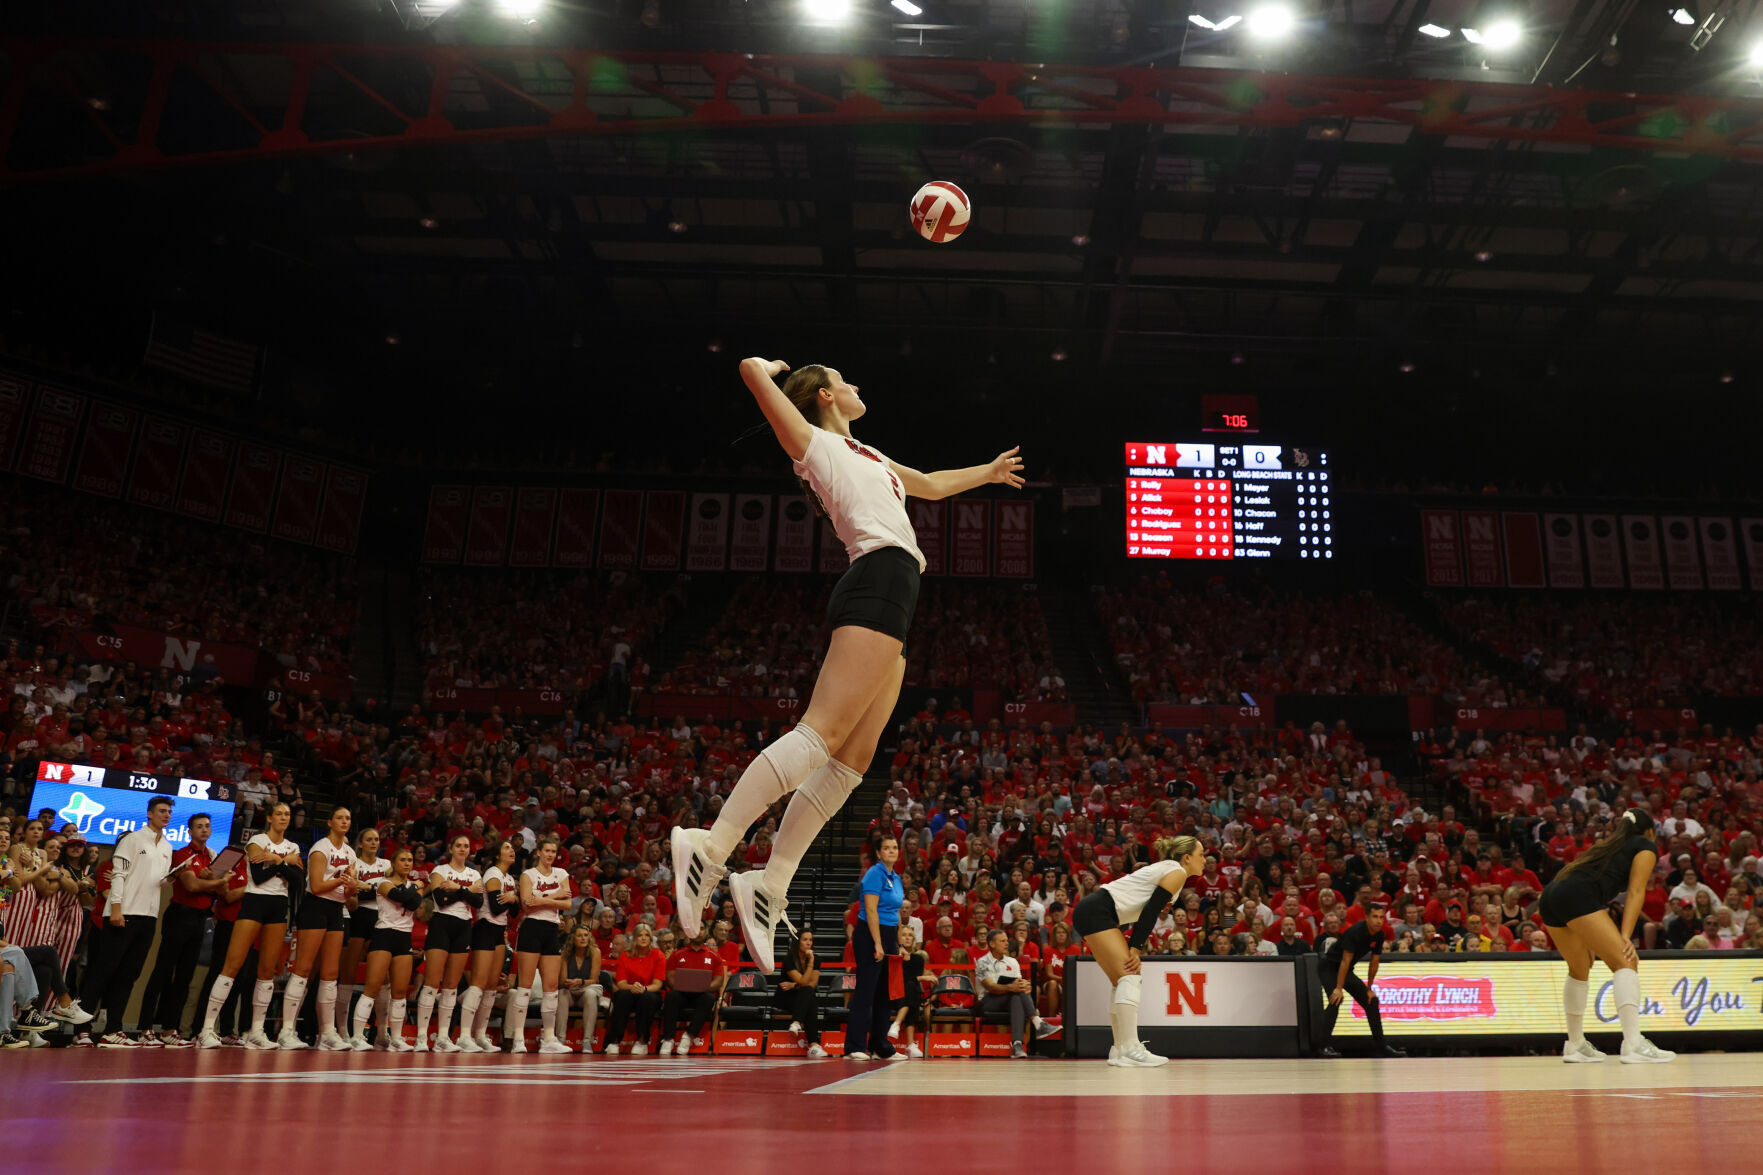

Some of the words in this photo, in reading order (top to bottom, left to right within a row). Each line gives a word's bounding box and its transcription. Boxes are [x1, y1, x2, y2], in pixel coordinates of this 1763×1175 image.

[1222, 415, 1248, 427] 7:06
[1146, 446, 1166, 464] N
[1196, 450, 1200, 462] 1
[1256, 451, 1264, 463] 0
[1222, 458, 1236, 466] 0-0
[1130, 468, 1175, 476] NEBRASKA
[1252, 471, 1273, 479] BEACH
[1296, 472, 1303, 480] K
[1308, 472, 1315, 480] B
[1194, 482, 1201, 490] 0
[1207, 482, 1214, 490] 0
[1220, 482, 1226, 490] 0
[1235, 483, 1239, 491] 1
[1244, 483, 1269, 493] Meyer
[1297, 485, 1304, 493] 0
[1309, 485, 1316, 493] 0
[1321, 485, 1328, 493] 0
[1194, 495, 1201, 503] 0
[1208, 495, 1214, 503] 0
[1234, 496, 1241, 504] 9
[1298, 497, 1305, 505] 0
[1322, 498, 1329, 506] 0
[915, 504, 941, 528] N
[958, 505, 984, 529] N
[1002, 505, 1026, 529] N
[1195, 508, 1202, 516] 0
[1208, 508, 1215, 516] 0
[1234, 509, 1243, 517] 10
[1245, 509, 1276, 517] Chacon
[1299, 510, 1305, 518] 0
[1311, 510, 1317, 518] 0
[1323, 511, 1329, 519] 0
[1195, 521, 1202, 529] 0
[1209, 521, 1215, 529] 0
[1223, 521, 1227, 529] 1
[1234, 522, 1243, 530] 16
[1299, 523, 1306, 531] 0
[1311, 523, 1318, 531] 0
[1428, 515, 1454, 540] N
[1468, 516, 1494, 540] N
[1196, 534, 1202, 542] 0
[1222, 535, 1228, 543] 0
[1246, 535, 1281, 545] Kennedy
[1312, 537, 1319, 545] 0
[1324, 537, 1331, 545] 0
[1129, 546, 1139, 554] 27
[1142, 547, 1171, 556] Murray
[1196, 548, 1203, 556] 0
[1210, 548, 1216, 556] 0
[1222, 548, 1229, 556] 0
[1247, 549, 1270, 557] Glenn
[1301, 550, 1307, 558] 0
[1313, 550, 1320, 558] 0
[1325, 550, 1332, 558] 0
[957, 558, 983, 571] 2000
[1000, 559, 1027, 574] 2006
[160, 636, 200, 671] N
[288, 669, 312, 682] C15
[435, 688, 457, 699] C16
[540, 690, 561, 702] C16
[776, 698, 799, 710] C17
[1005, 703, 1026, 714] C17
[1239, 706, 1261, 718] C18
[1457, 708, 1479, 719] C18
[45, 764, 64, 780] N
[87, 770, 92, 781] 1
[129, 775, 158, 790] 1:30
[189, 784, 198, 795] 0
[739, 974, 755, 988] N
[842, 975, 856, 989] N
[946, 976, 961, 990] N
[1165, 971, 1208, 1016] N
[1672, 976, 1745, 1026] You
